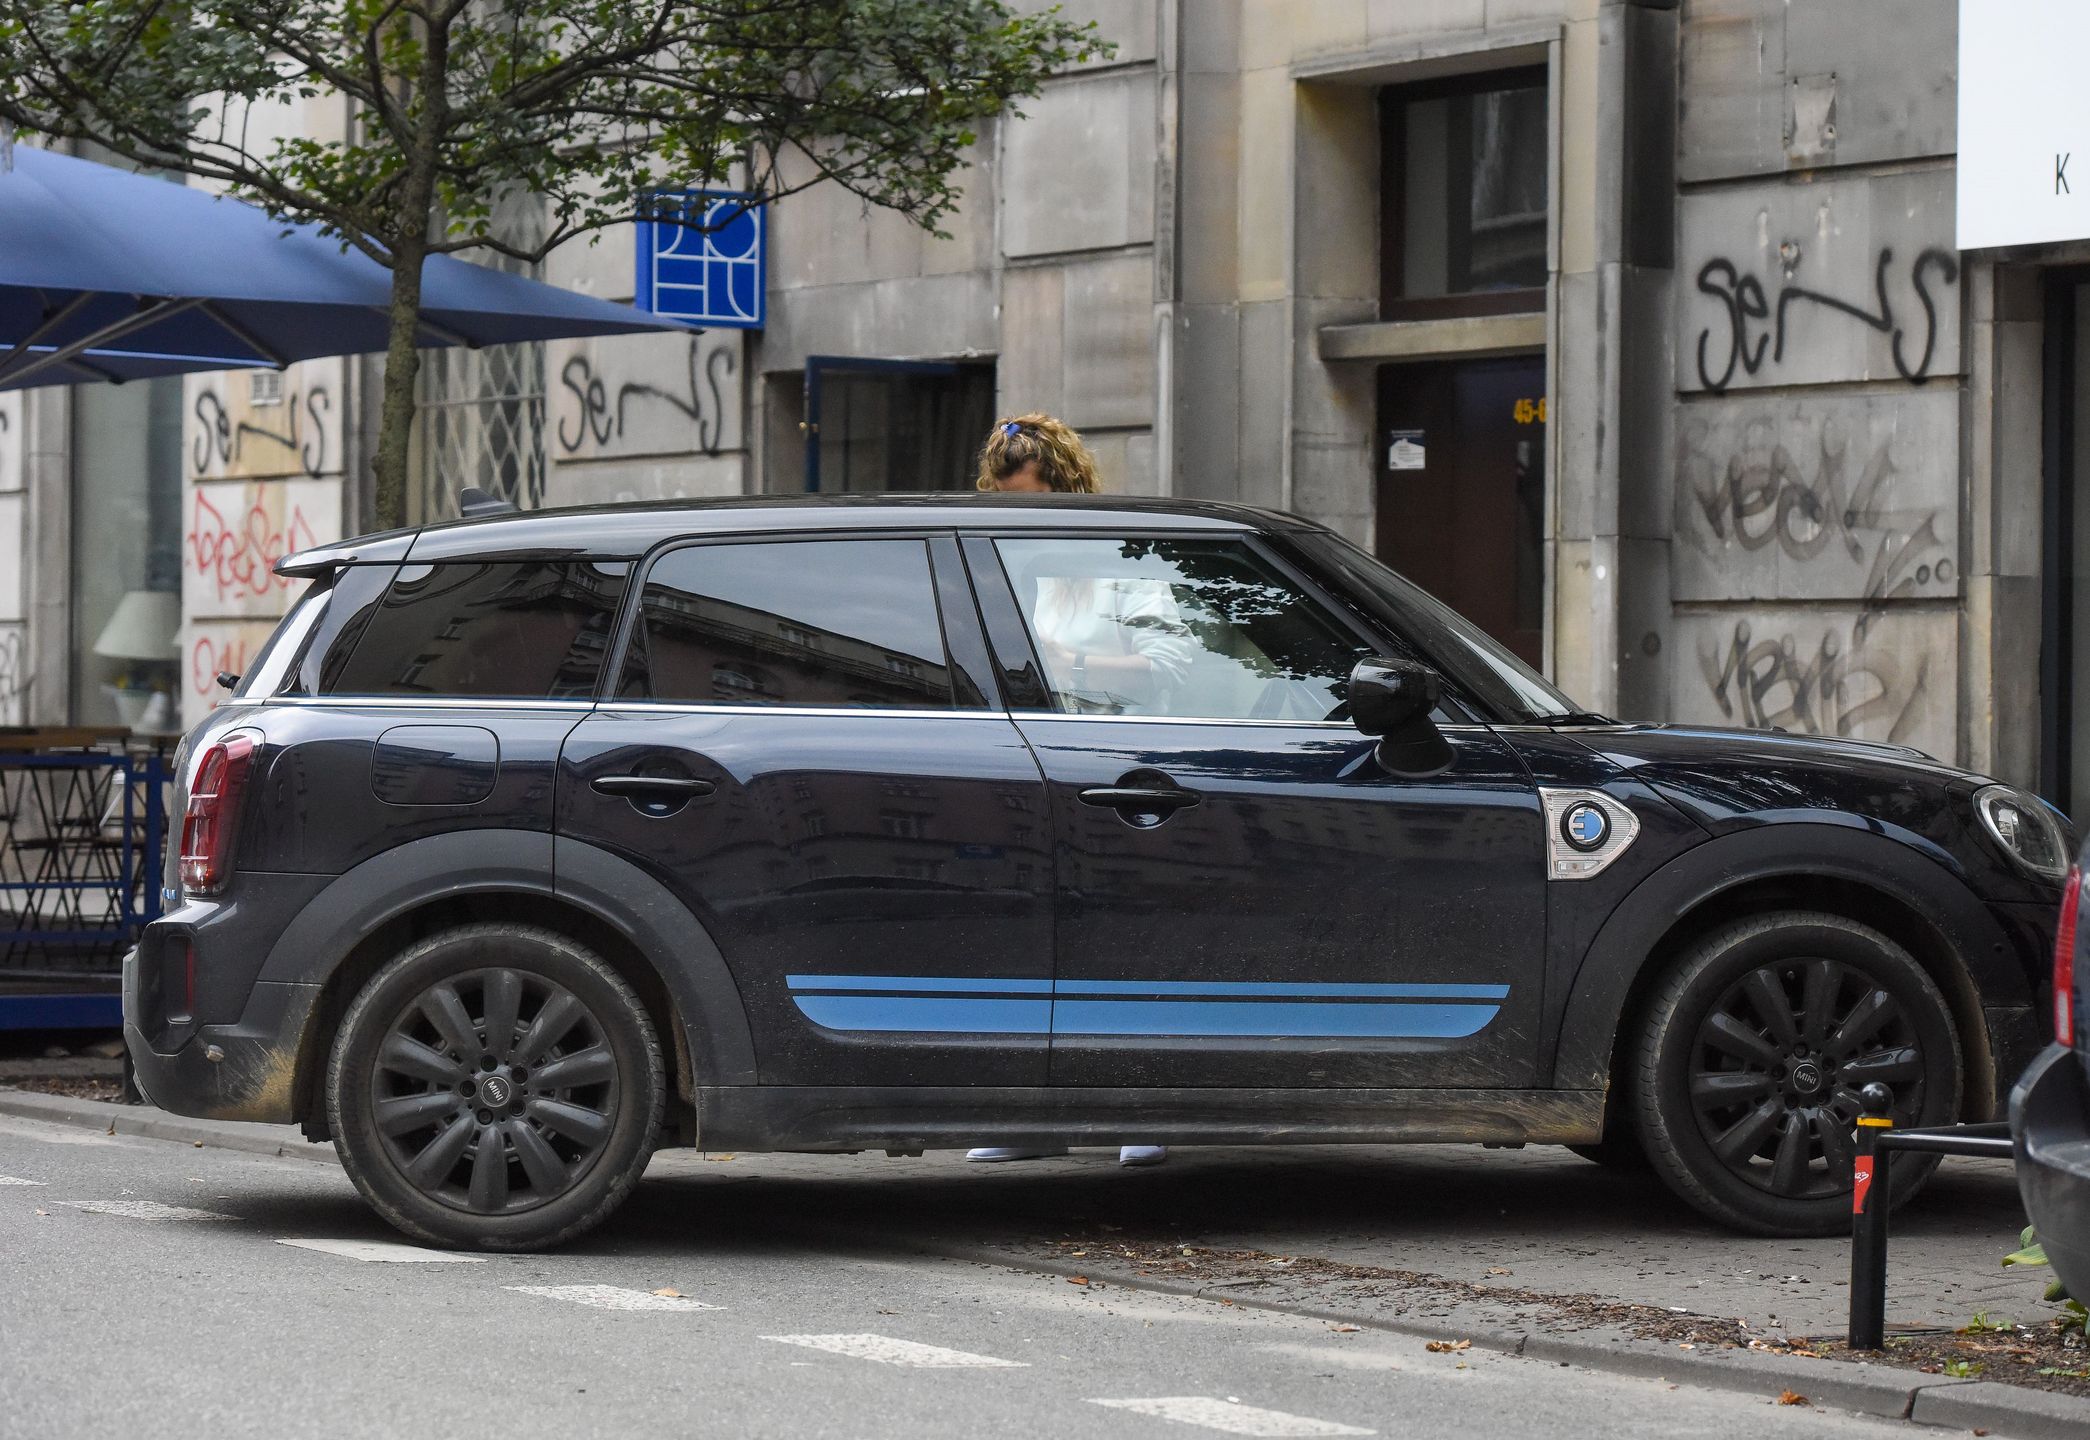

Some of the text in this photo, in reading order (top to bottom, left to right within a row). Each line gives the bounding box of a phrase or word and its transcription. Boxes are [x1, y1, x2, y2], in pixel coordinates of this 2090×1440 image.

[2055, 152, 2070, 195] K
[1796, 1070, 1817, 1085] MINI
[487, 1080, 504, 1102] MINI
